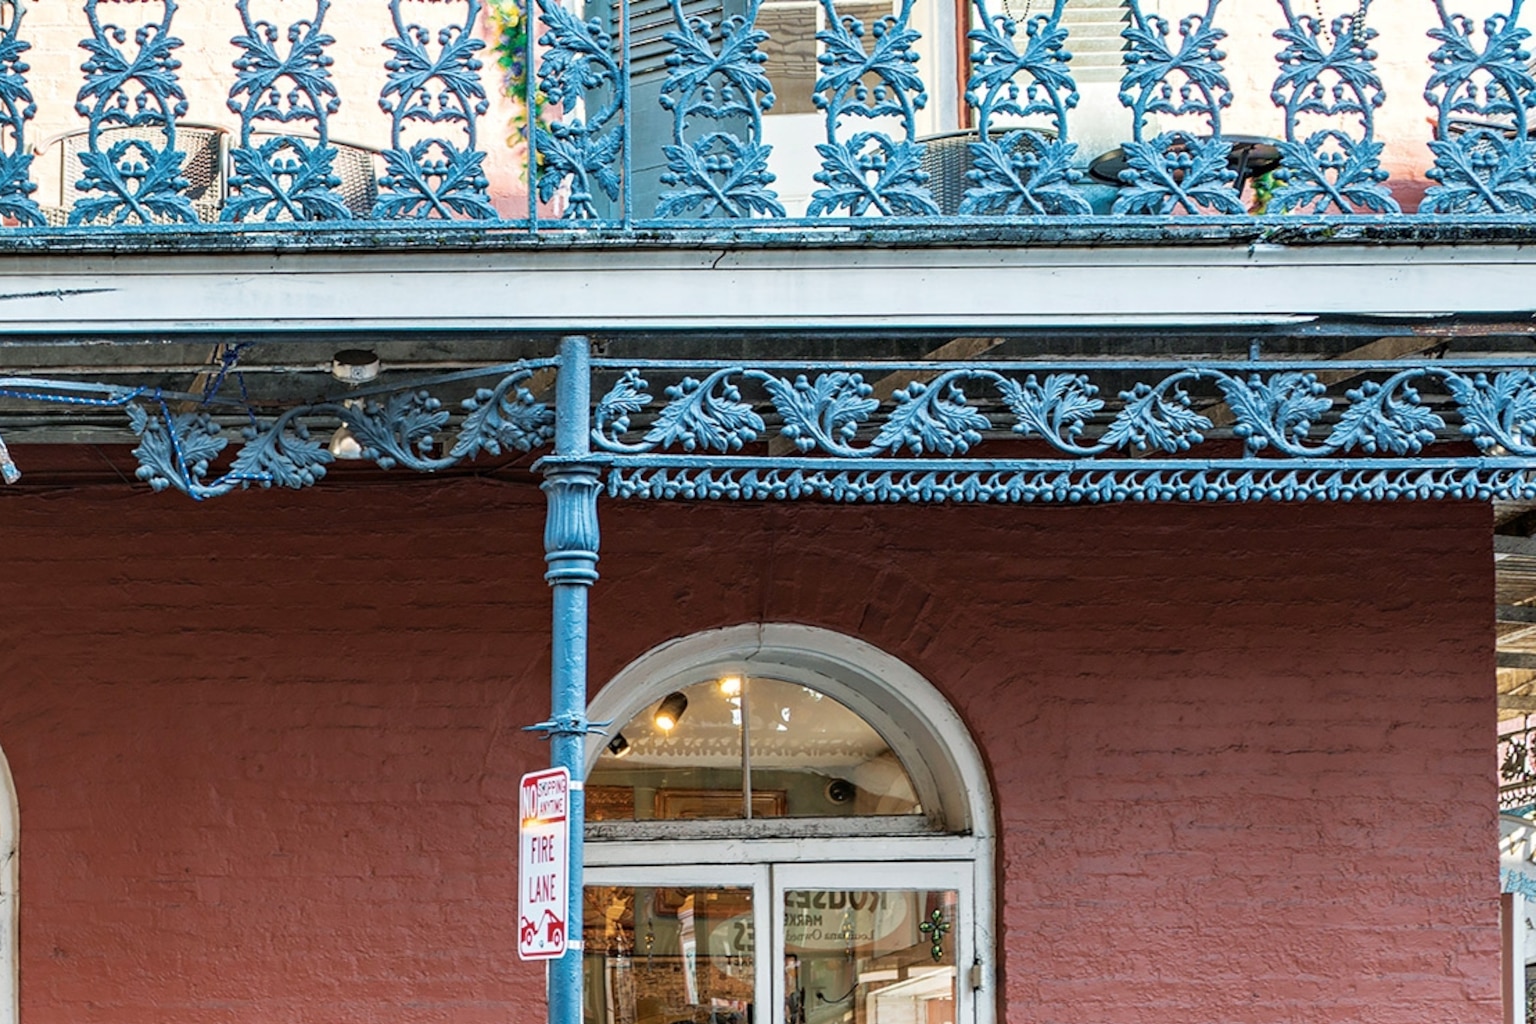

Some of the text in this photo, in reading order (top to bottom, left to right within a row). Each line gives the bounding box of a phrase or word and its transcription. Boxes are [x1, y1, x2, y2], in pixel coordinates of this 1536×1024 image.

[523, 784, 538, 819] NO
[531, 834, 555, 864] FIRE
[529, 874, 556, 903] LANE
